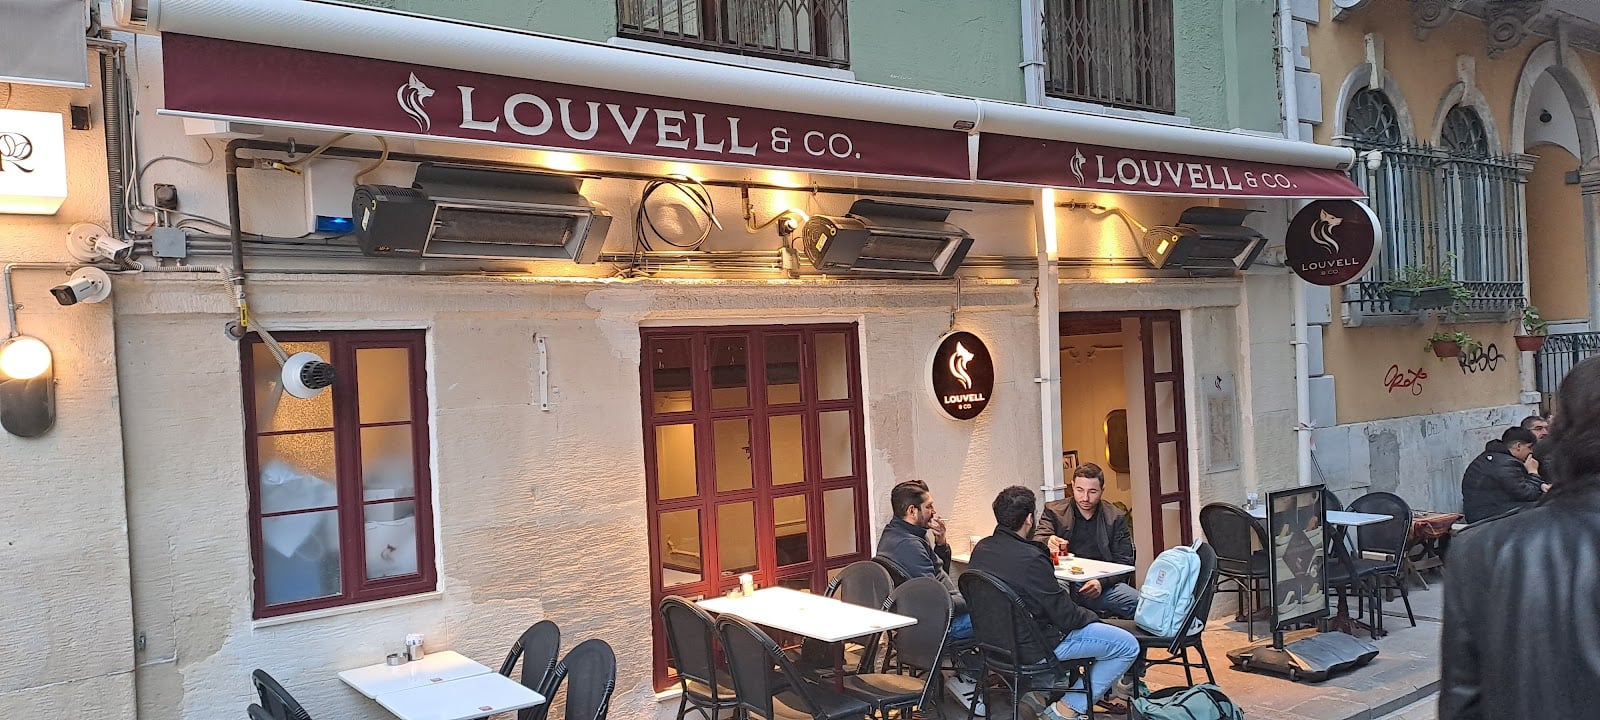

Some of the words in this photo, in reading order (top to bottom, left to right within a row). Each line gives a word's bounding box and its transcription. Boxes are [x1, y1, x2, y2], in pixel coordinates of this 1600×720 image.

[457, 85, 758, 157] LOUVELL
[770, 127, 792, 153] &
[803, 130, 862, 159] CO.
[1095, 154, 1243, 191] LOUVELL
[1244, 171, 1258, 188] &
[1261, 172, 1298, 189] CO.
[1302, 257, 1359, 271] LOUVELL
[943, 393, 985, 404] LOUVELL
